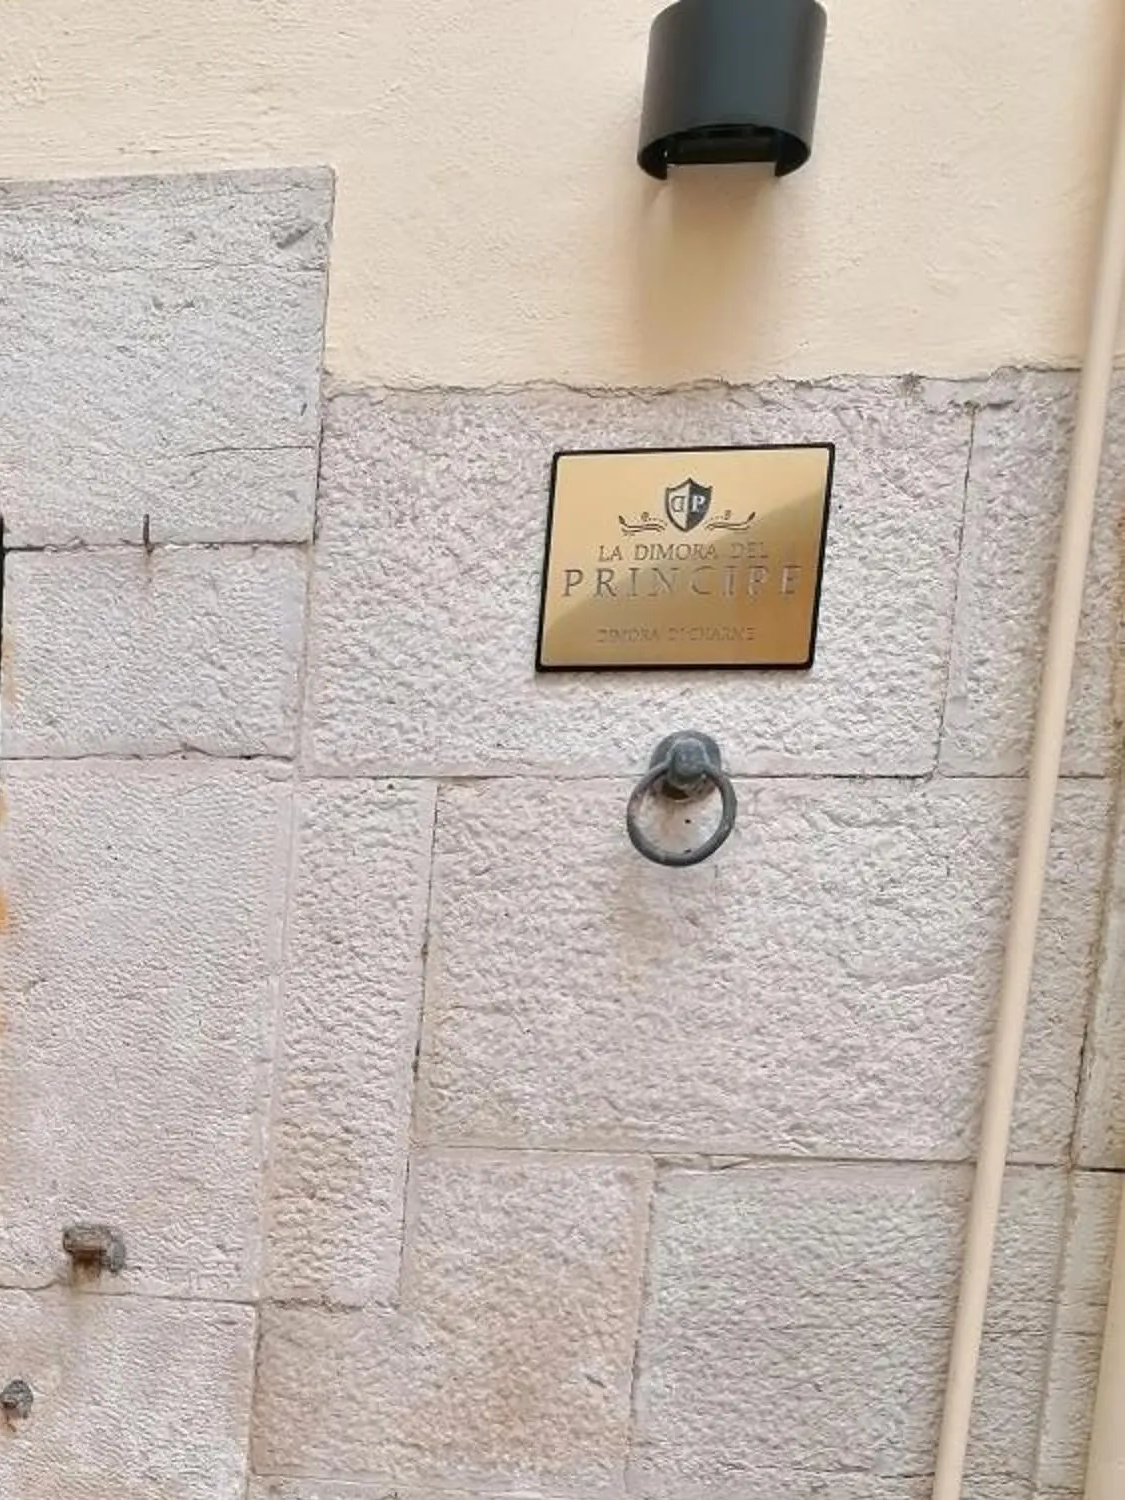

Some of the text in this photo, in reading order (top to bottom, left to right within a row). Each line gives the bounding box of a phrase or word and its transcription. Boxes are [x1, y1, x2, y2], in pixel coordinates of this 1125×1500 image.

[598, 542, 769, 562] LA DIMORA DEL
[562, 565, 803, 598] PRINCIPE
